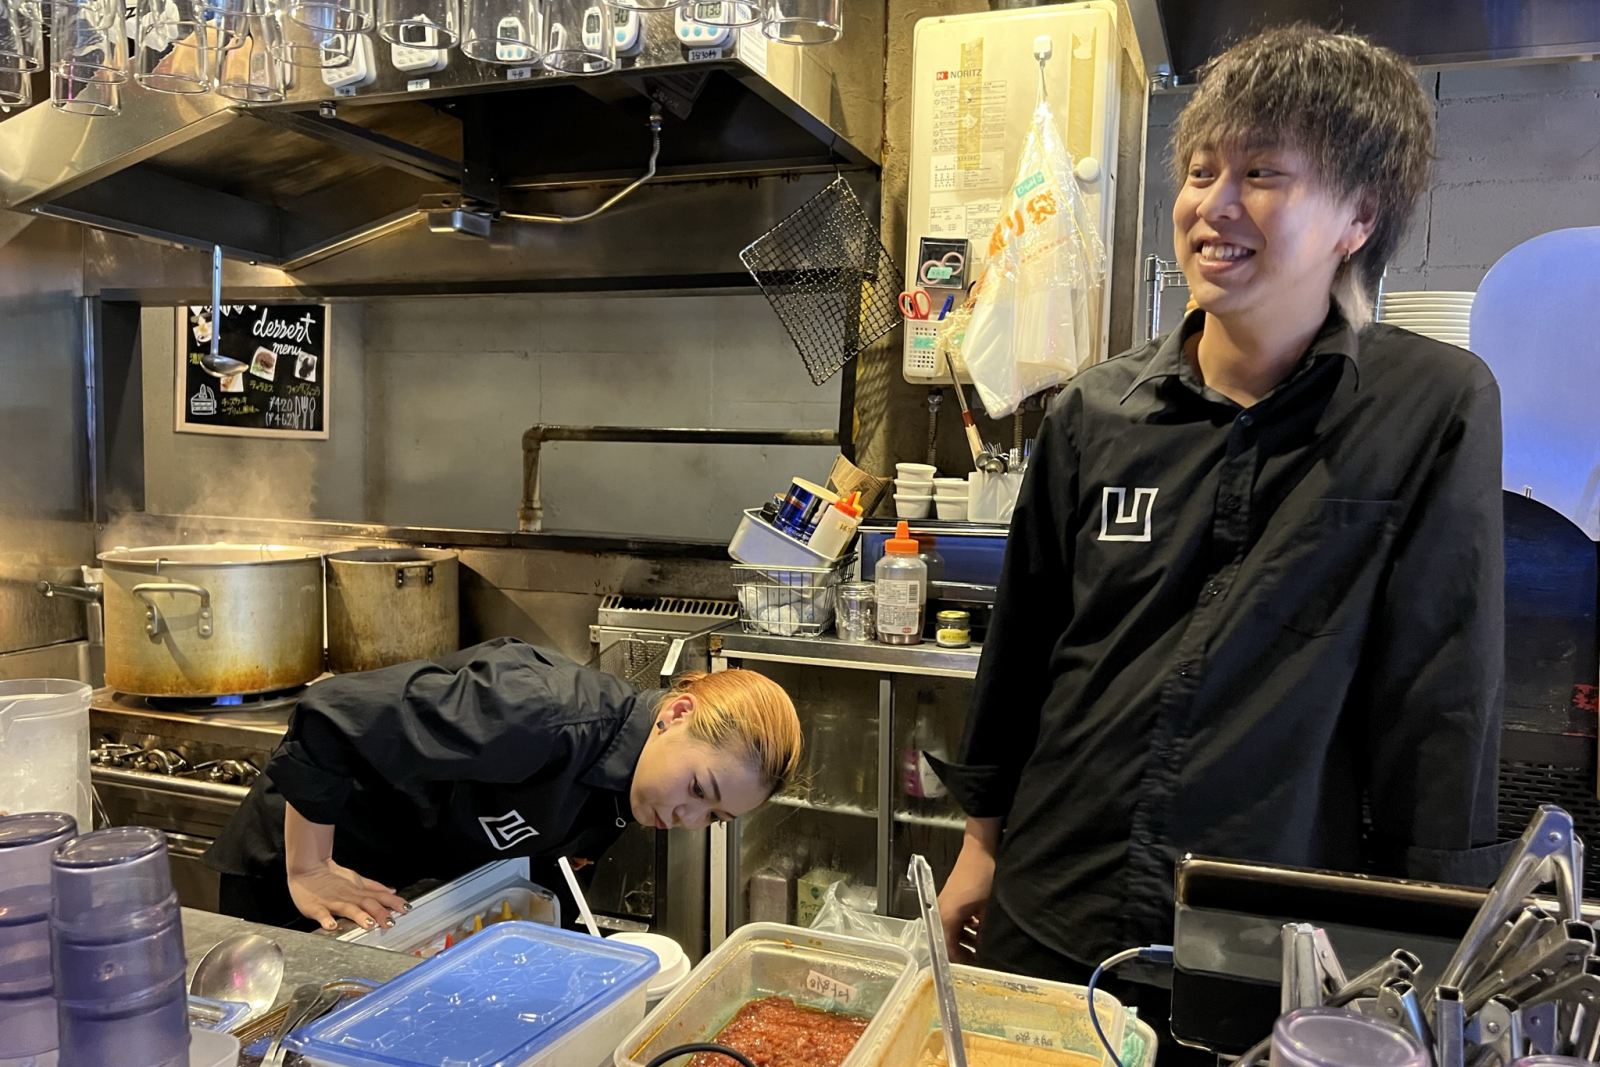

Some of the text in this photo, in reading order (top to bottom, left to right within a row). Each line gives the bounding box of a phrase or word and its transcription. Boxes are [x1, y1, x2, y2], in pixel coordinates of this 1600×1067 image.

[951, 69, 982, 79] NORITZ
[253, 307, 316, 345] dessert
[273, 342, 301, 355] menu
